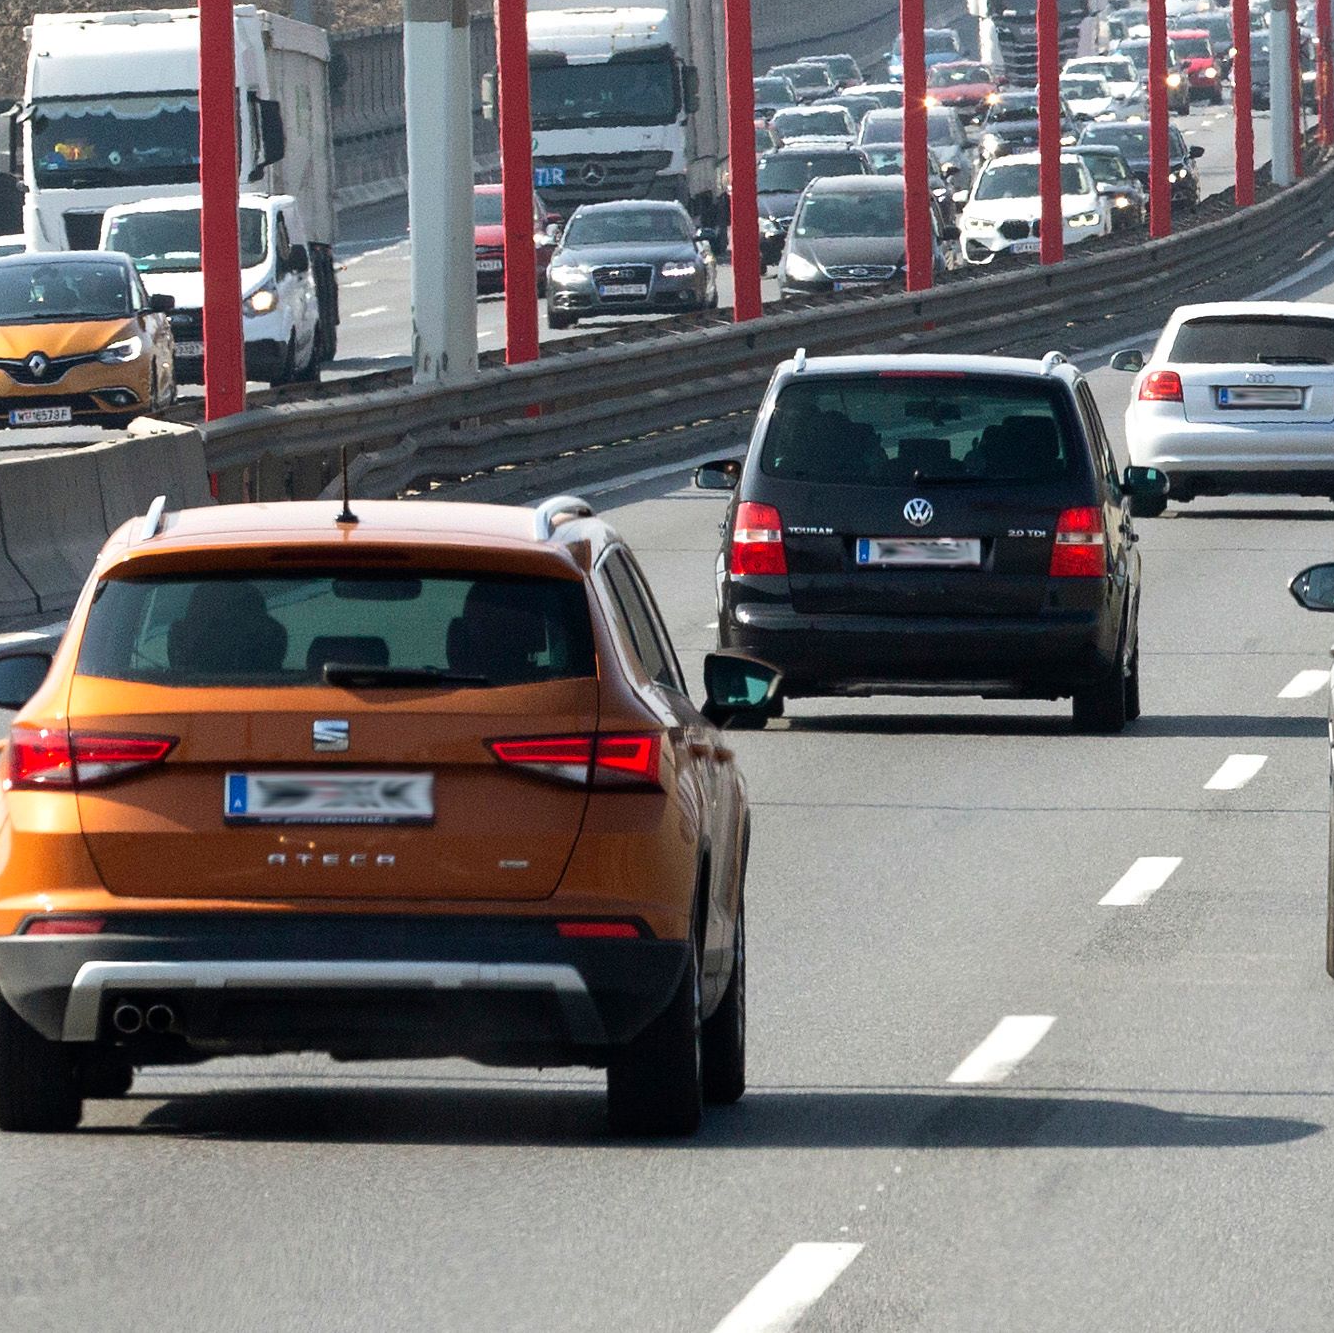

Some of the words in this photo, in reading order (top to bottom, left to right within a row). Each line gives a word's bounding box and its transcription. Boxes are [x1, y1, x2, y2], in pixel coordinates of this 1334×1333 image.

[535, 167, 566, 186] TIR
[788, 526, 834, 536] TOURAN
[1028, 529, 1047, 538] TDI
[267, 852, 396, 867] ATECA
